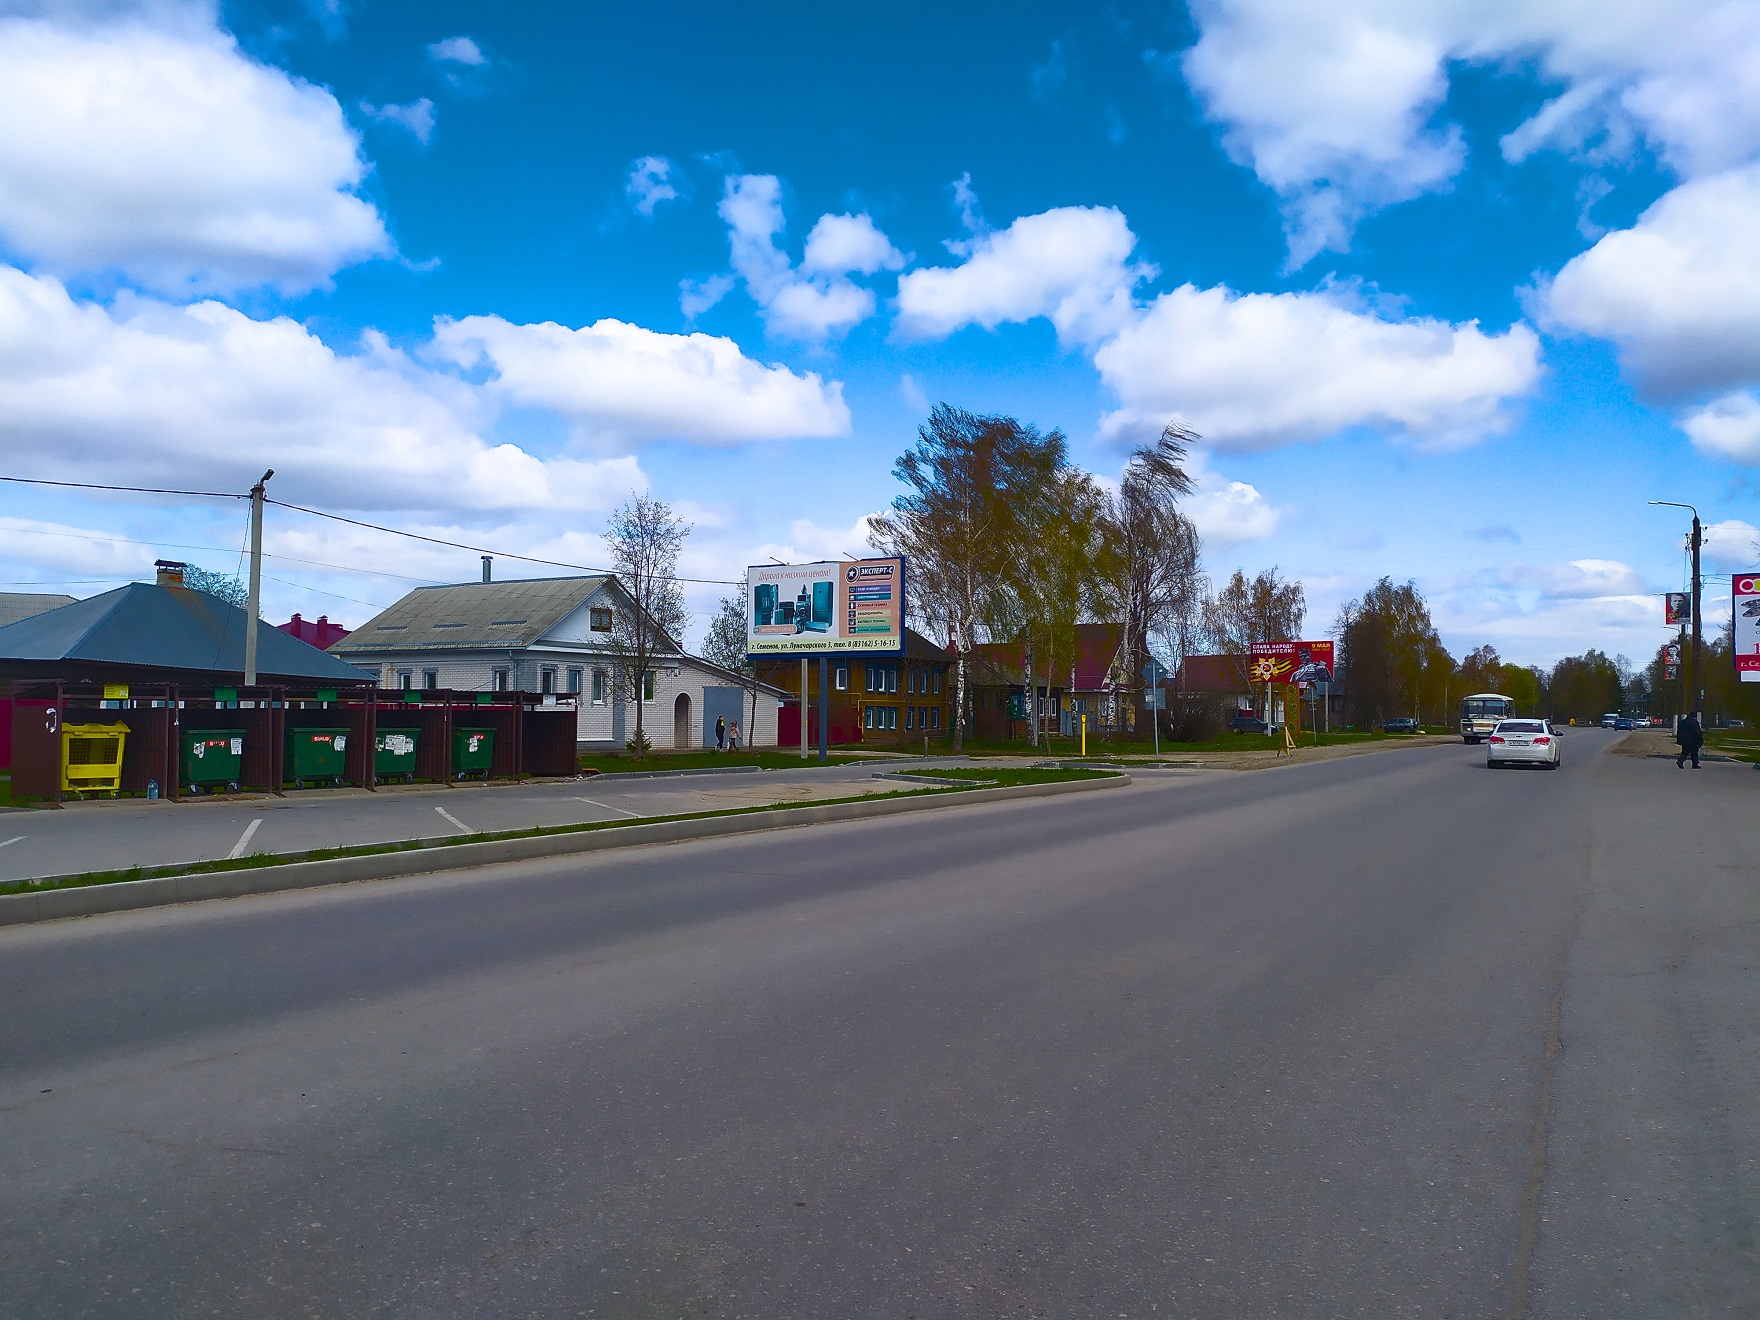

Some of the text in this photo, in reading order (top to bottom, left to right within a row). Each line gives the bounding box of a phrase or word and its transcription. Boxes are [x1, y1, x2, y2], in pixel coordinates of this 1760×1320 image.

[758, 571, 779, 581] Дорога
[785, 571, 807, 579] низким
[808, 568, 831, 578] ценам!
[860, 566, 893, 575] ЭКСПЕРТ-С
[789, 642, 827, 651] Луначарского
[827, 641, 833, 649] 3,
[847, 640, 852, 648] 8
[852, 640, 873, 648] (83162)
[874, 639, 896, 647] 5-16-15
